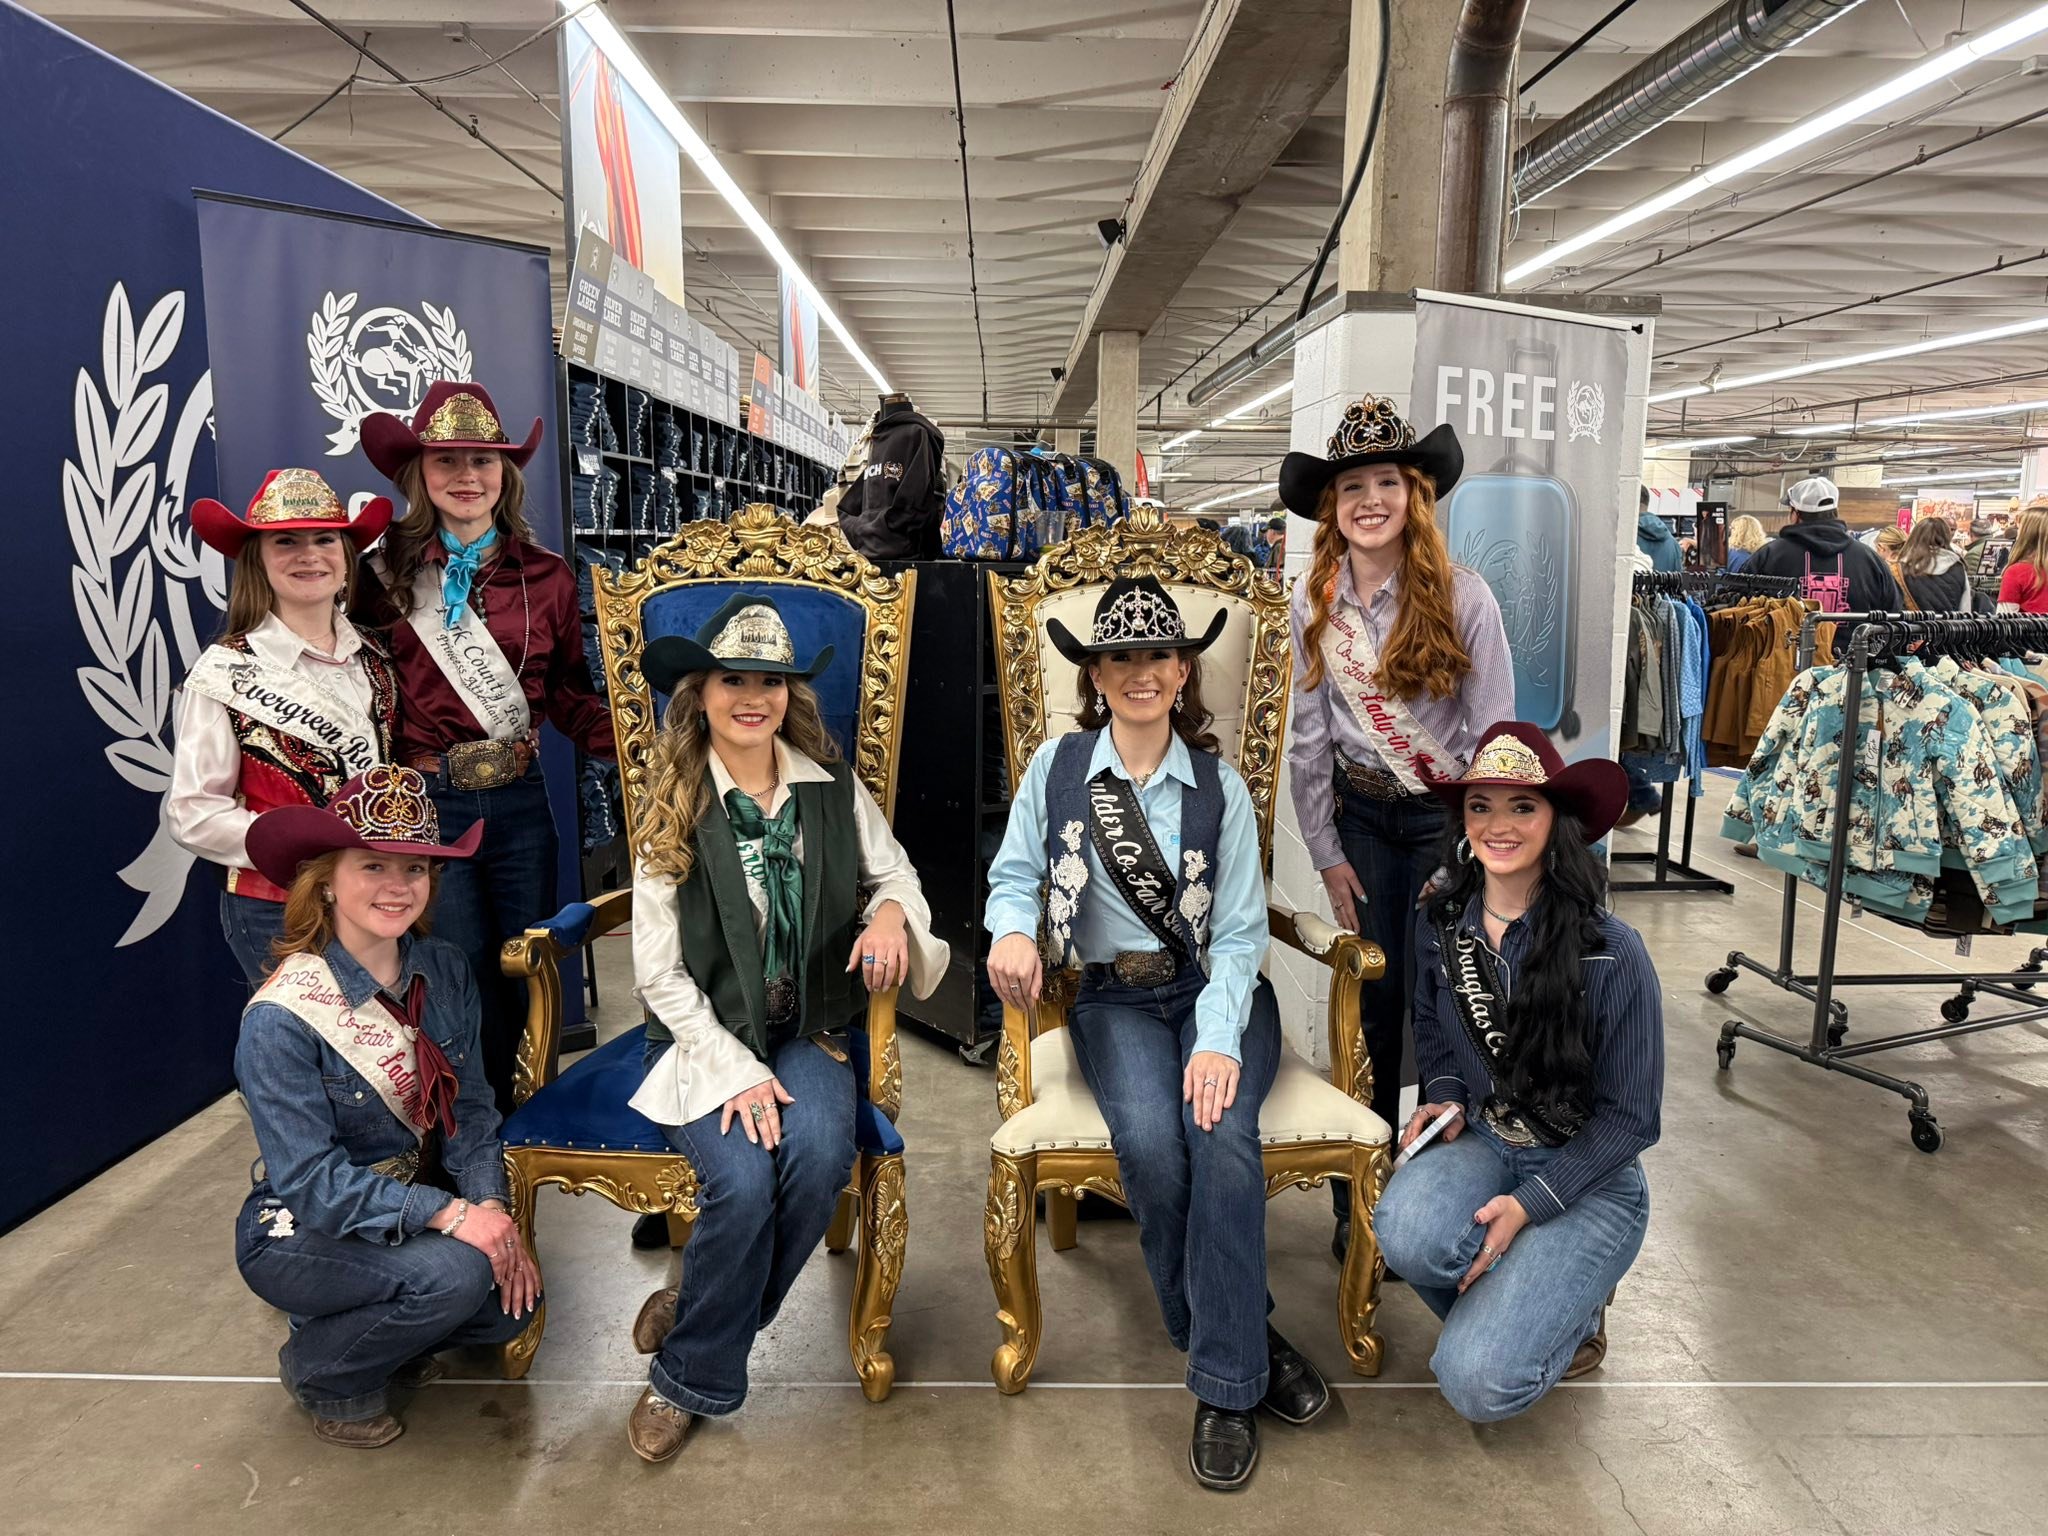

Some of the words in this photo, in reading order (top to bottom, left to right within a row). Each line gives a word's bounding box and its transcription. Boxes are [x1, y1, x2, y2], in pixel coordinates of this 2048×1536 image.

[577, 292, 597, 314] LABEL
[579, 279, 600, 301] GREEN
[603, 308, 622, 328] LABEL
[1435, 366, 1556, 440] FREE
[1328, 610, 1356, 639] Adams
[437, 634, 467, 675] Princess
[463, 676, 503, 726] Attendant
[464, 645, 506, 702] County
[504, 704, 523, 736] Fair
[231, 671, 343, 745] Evergreen
[1113, 841, 1142, 873] Co.
[1127, 871, 1168, 915] Fair
[276, 970, 320, 988] 2025
[1455, 935, 1495, 1029] Douglas
[299, 985, 349, 1007] Adam
[354, 1024, 394, 1048] Fair
